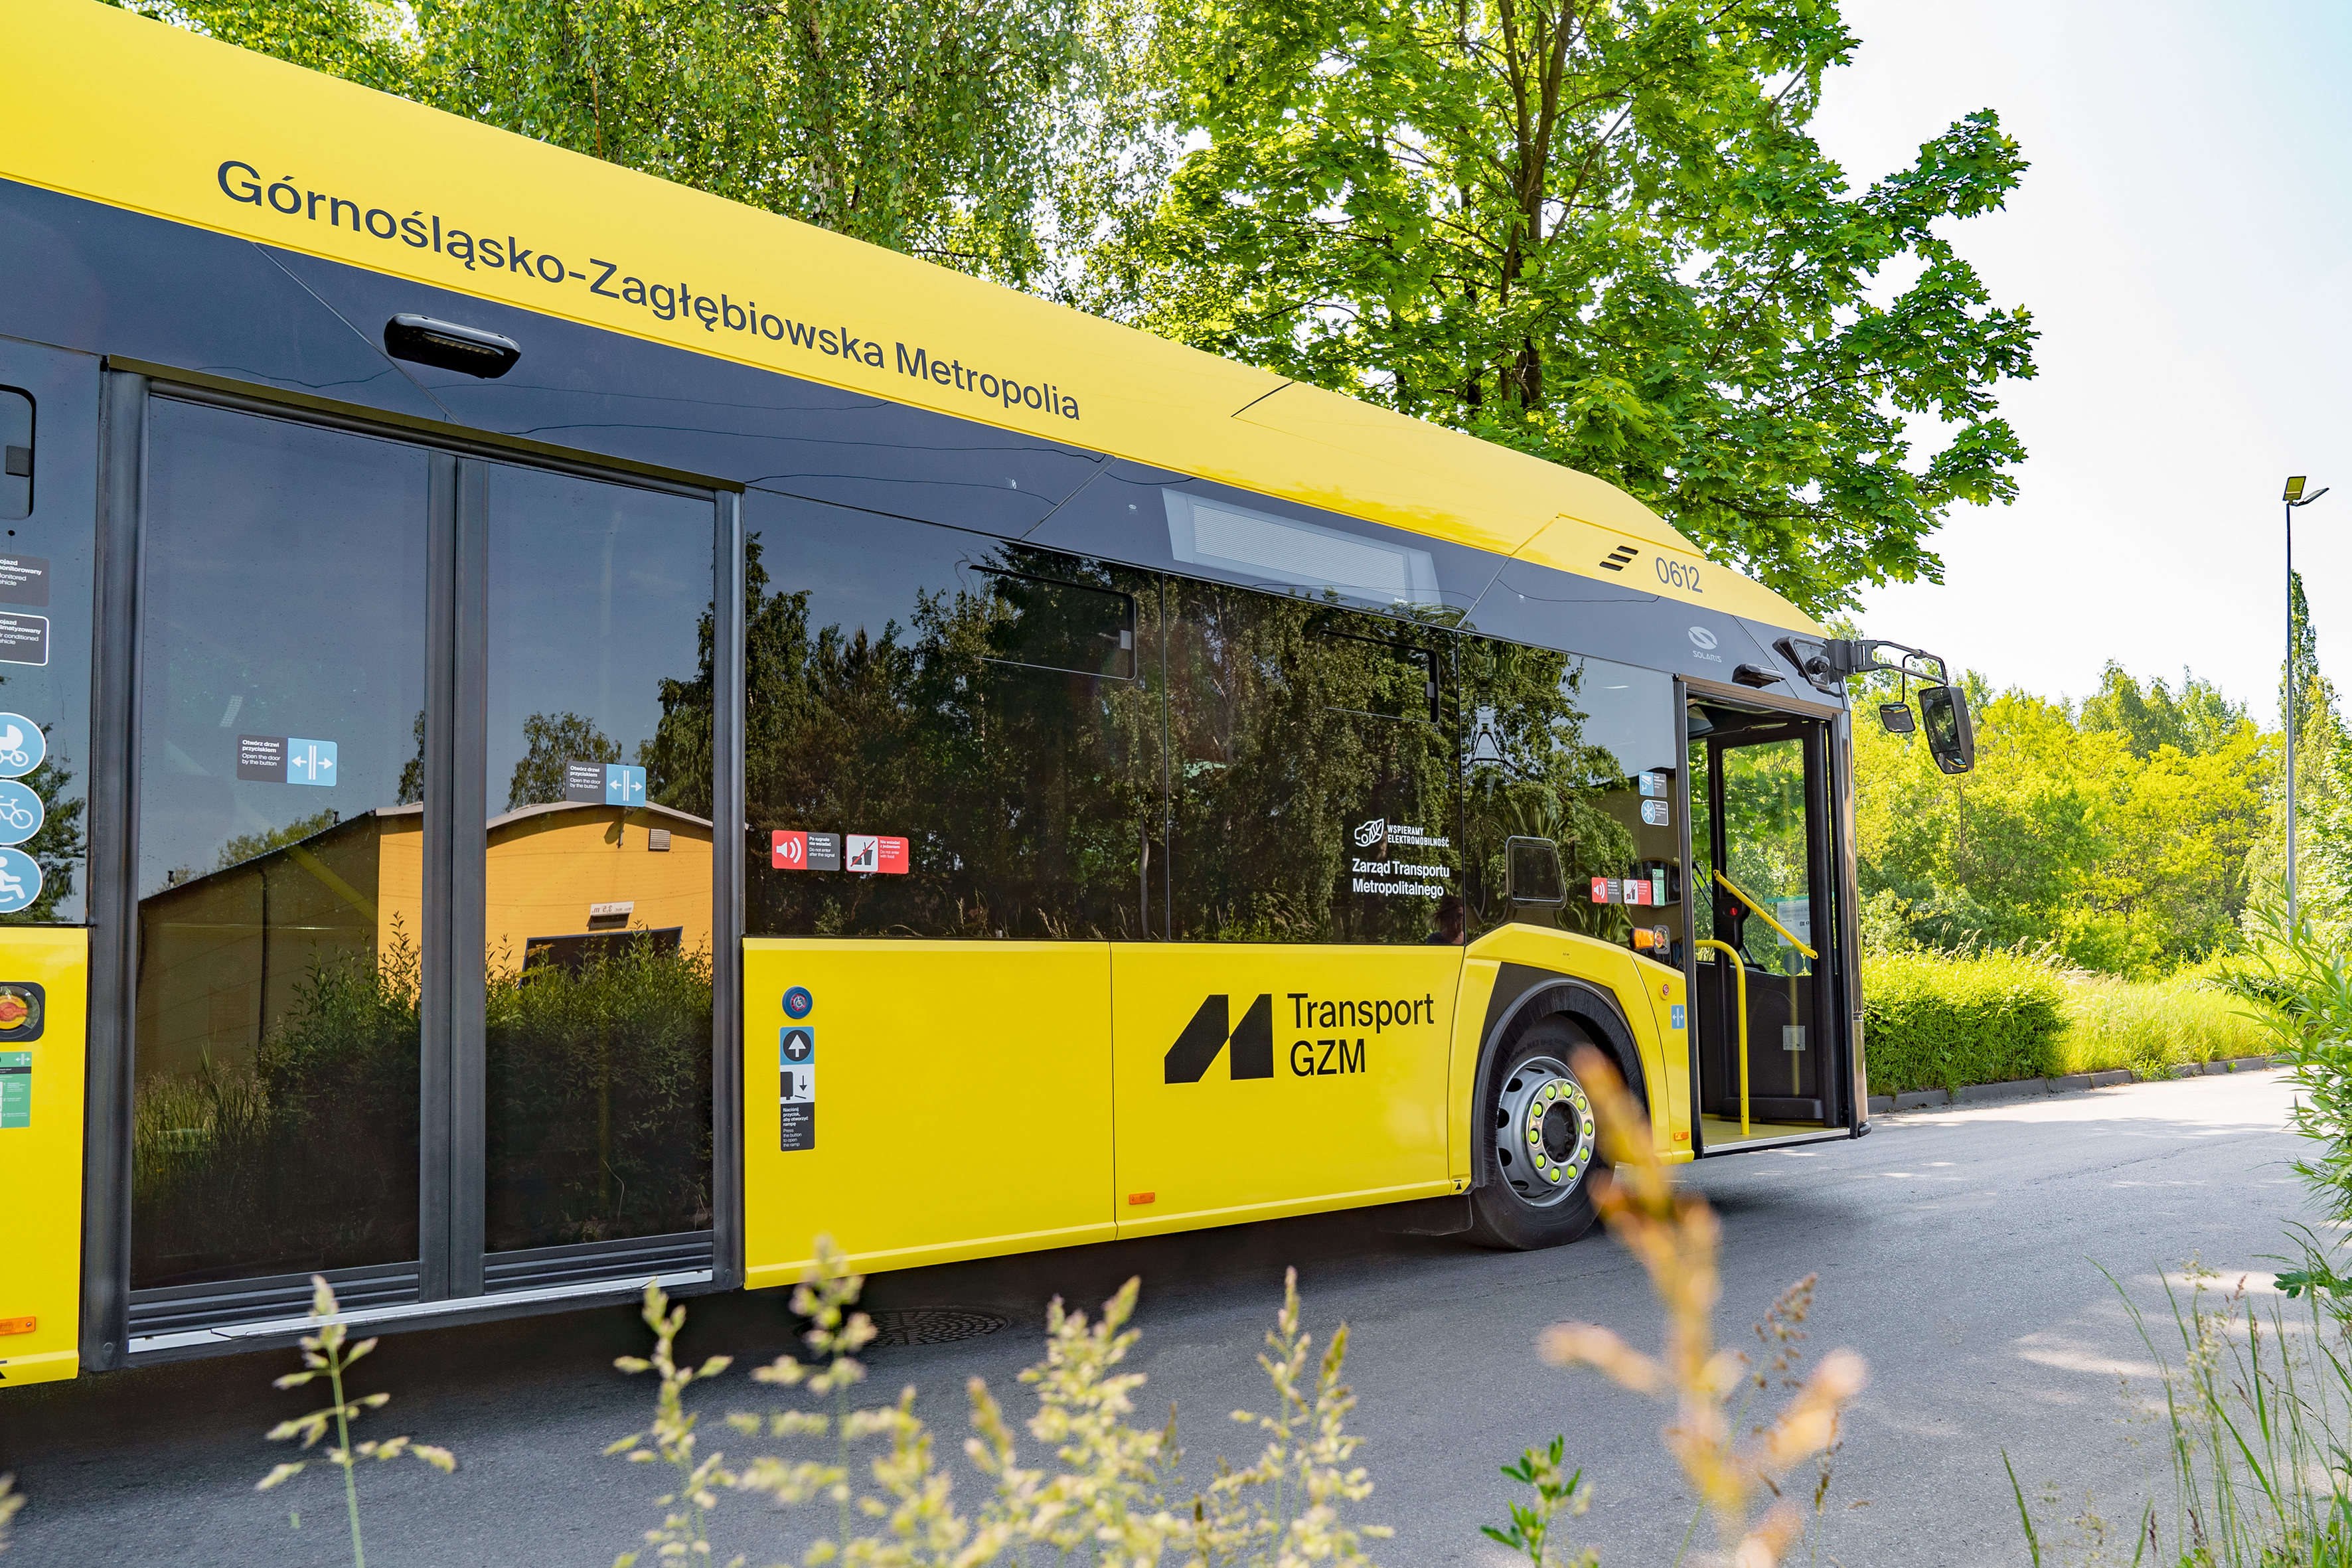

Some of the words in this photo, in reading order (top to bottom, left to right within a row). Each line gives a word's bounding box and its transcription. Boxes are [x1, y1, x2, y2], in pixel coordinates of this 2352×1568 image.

[217, 160, 885, 368] Górnośląsko-Zagłębiowska
[896, 341, 1080, 420] Metropolia
[0, 572, 27, 581] onitored
[1656, 556, 1703, 593] 0612
[0, 624, 41, 635] limatyzowany
[4, 633, 39, 642] conditioned
[1692, 650, 1722, 663] SOLARIS
[1387, 824, 1424, 836] WSPIERAMY
[1387, 834, 1449, 847] ELEKTROMOBILNOŚĆ
[1352, 858, 1391, 877] Zarząd
[1392, 860, 1450, 879] Transportu
[1352, 878, 1444, 899] Metropolitalnego
[1287, 992, 1435, 1034] Transport
[1290, 1038, 1366, 1077] GZM
